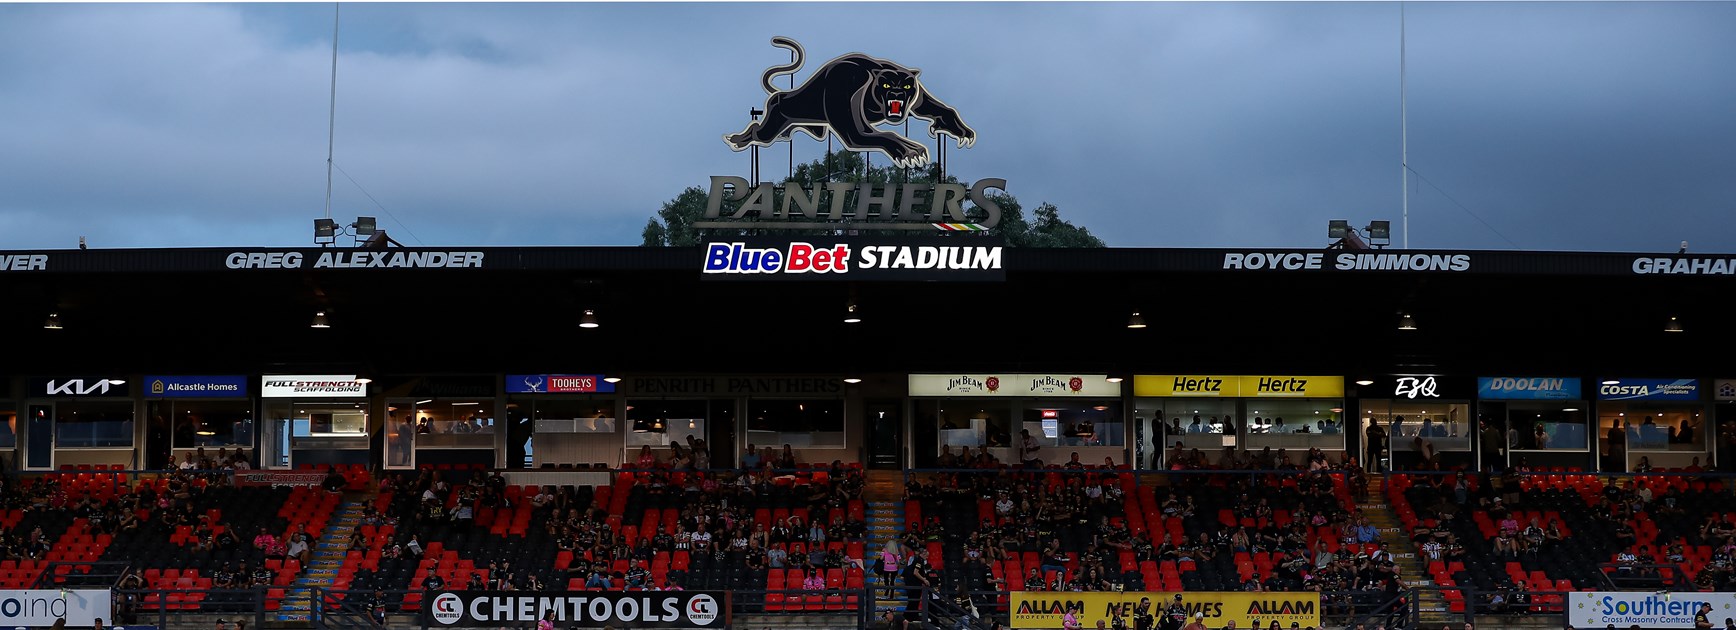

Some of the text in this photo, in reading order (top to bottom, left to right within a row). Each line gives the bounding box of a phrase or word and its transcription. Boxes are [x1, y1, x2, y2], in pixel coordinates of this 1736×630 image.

[705, 175, 1006, 228] PANTHERS
[225, 251, 485, 269] GREG ALEXANDER
[858, 245, 1003, 270] STADIUM
[1222, 252, 1471, 271] ROYCE SIMMONS
[47, 379, 109, 394] KIA
[167, 383, 238, 391] Allcastle Homes
[430, 383, 491, 395] Williams
[552, 378, 592, 388] TOOHEYS
[634, 378, 840, 393] PENRITH PANTHERS
[947, 378, 961, 391] JIM
[962, 375, 983, 391] BEAM
[1030, 378, 1045, 391] JIM
[1045, 375, 1066, 391] BEAM
[1172, 376, 1222, 392] Hertz
[1257, 377, 1308, 392] Hertz
[1490, 377, 1563, 391] DOOLAN
[1600, 385, 1649, 396] COSTA
[469, 596, 680, 622] CHEMTOOLS
[1016, 600, 1084, 614] ALLAM
[1247, 600, 1314, 614] ALLAM
[1602, 596, 1704, 615] Southern
[1624, 616, 1657, 624] Masonry
